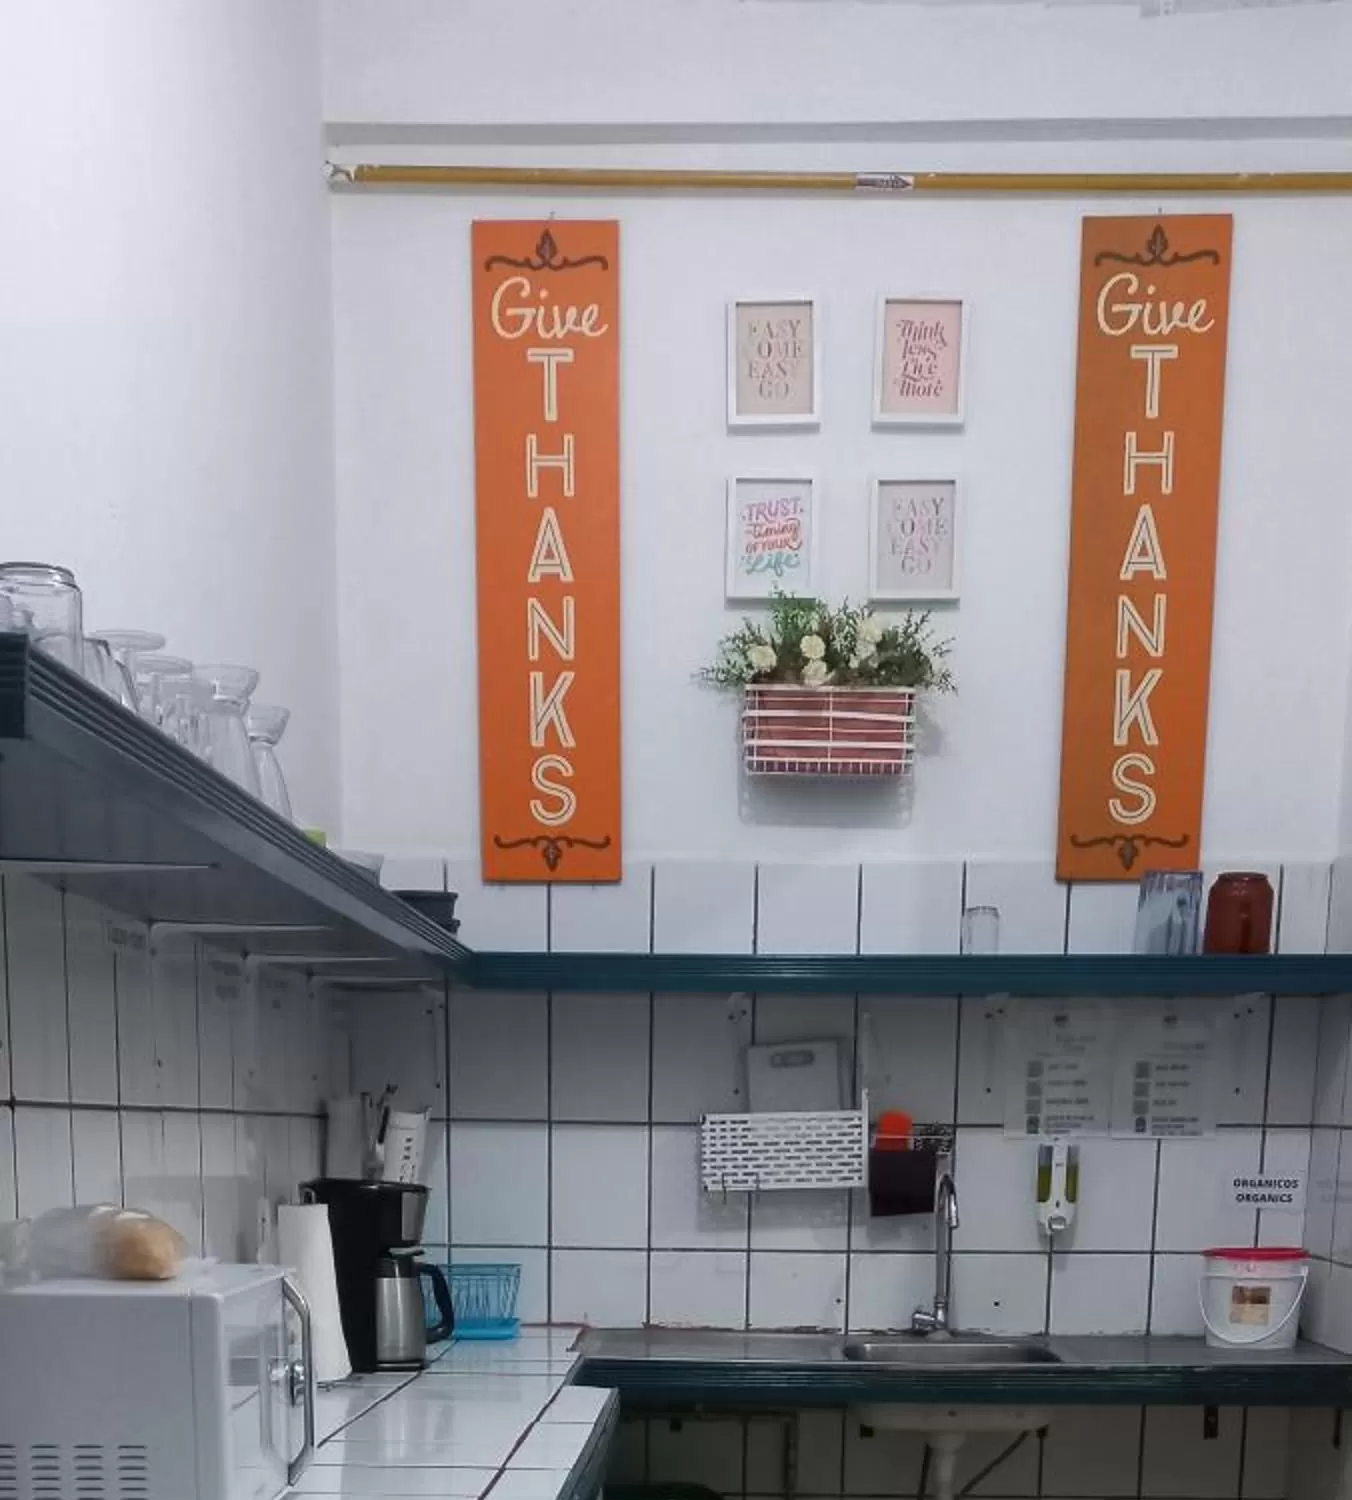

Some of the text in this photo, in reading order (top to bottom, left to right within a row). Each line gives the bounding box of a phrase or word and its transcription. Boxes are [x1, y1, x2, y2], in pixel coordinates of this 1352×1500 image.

[491, 276, 608, 339] Give
[1096, 271, 1215, 336] Give
[748, 319, 801, 340] EASY
[896, 319, 948, 349] Think
[746, 496, 801, 522] TRUST
[525, 347, 577, 827] THANKS
[1108, 343, 1178, 826] THANKS
[1235, 1193, 1294, 1203] ORGANICS
